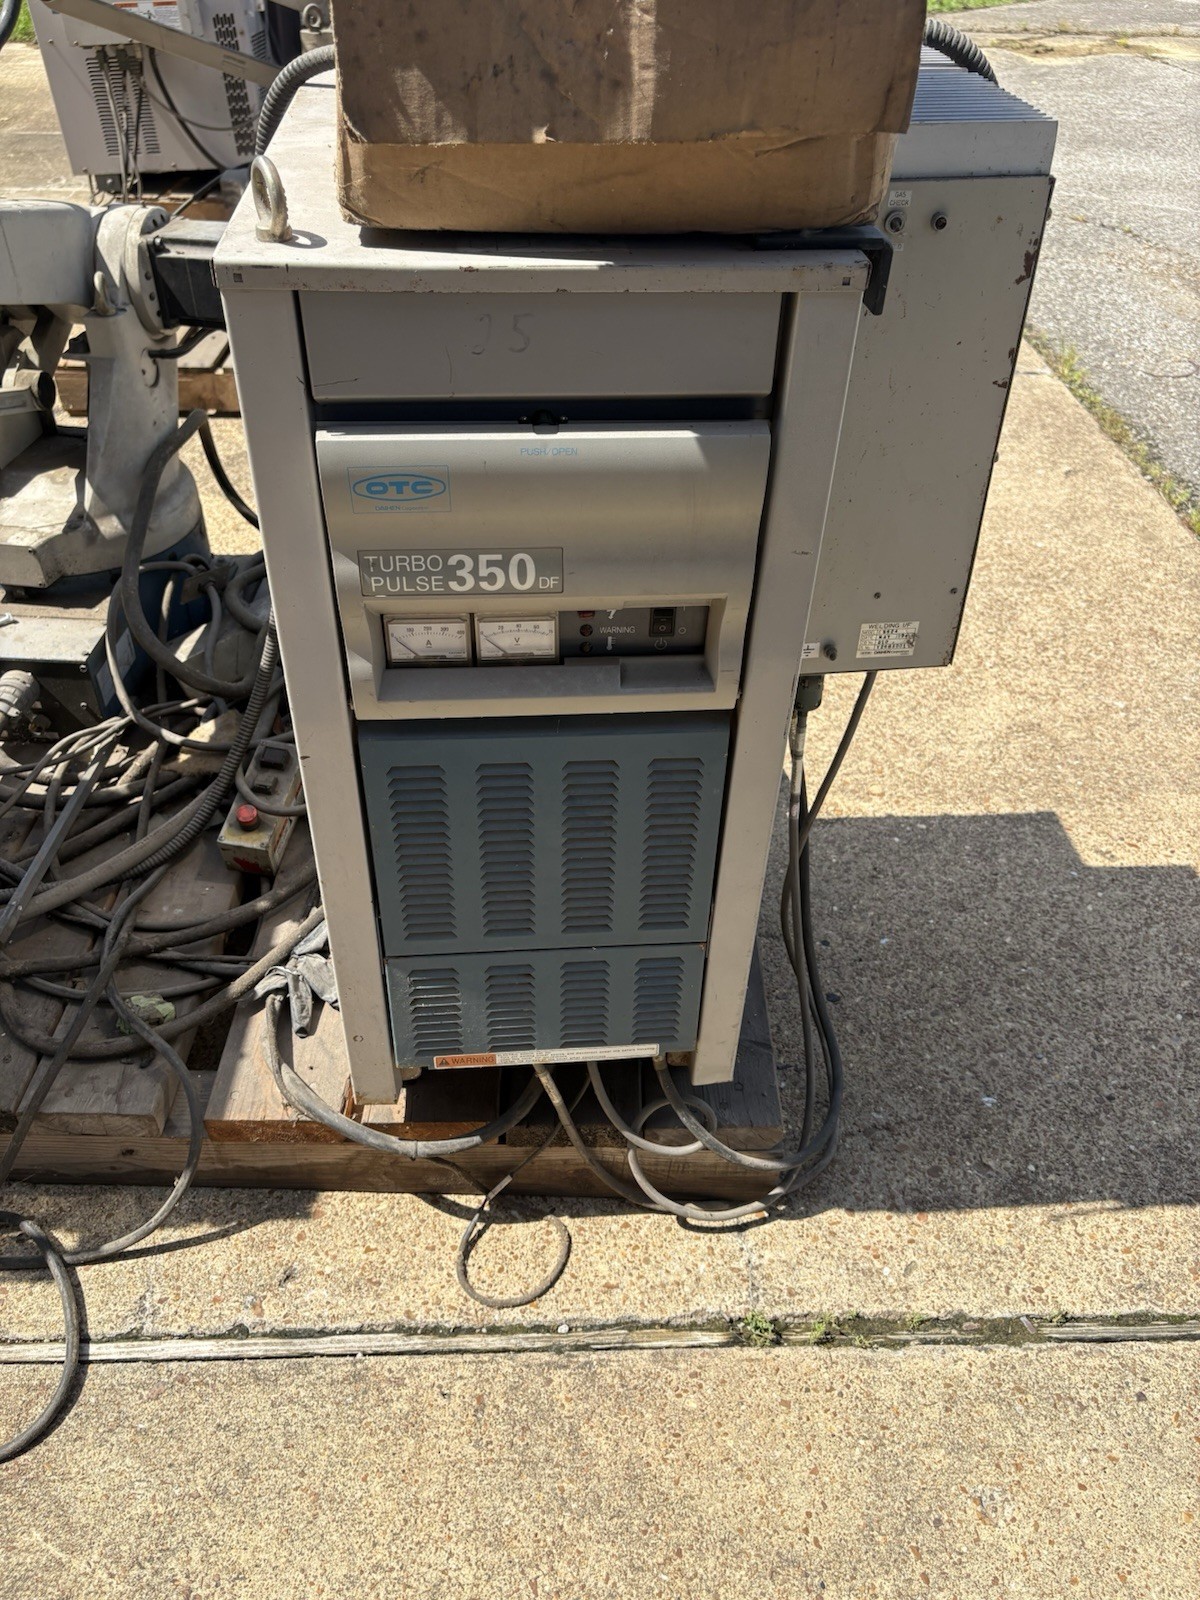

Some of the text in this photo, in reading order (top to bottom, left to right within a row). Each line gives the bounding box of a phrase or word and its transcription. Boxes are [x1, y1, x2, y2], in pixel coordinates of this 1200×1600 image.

[365, 481, 434, 495] OTC
[364, 555, 443, 572] TURBO
[371, 553, 560, 592] PULSE 350 DF
[600, 626, 636, 634] WARNING
[451, 1056, 494, 1065] WARNING
